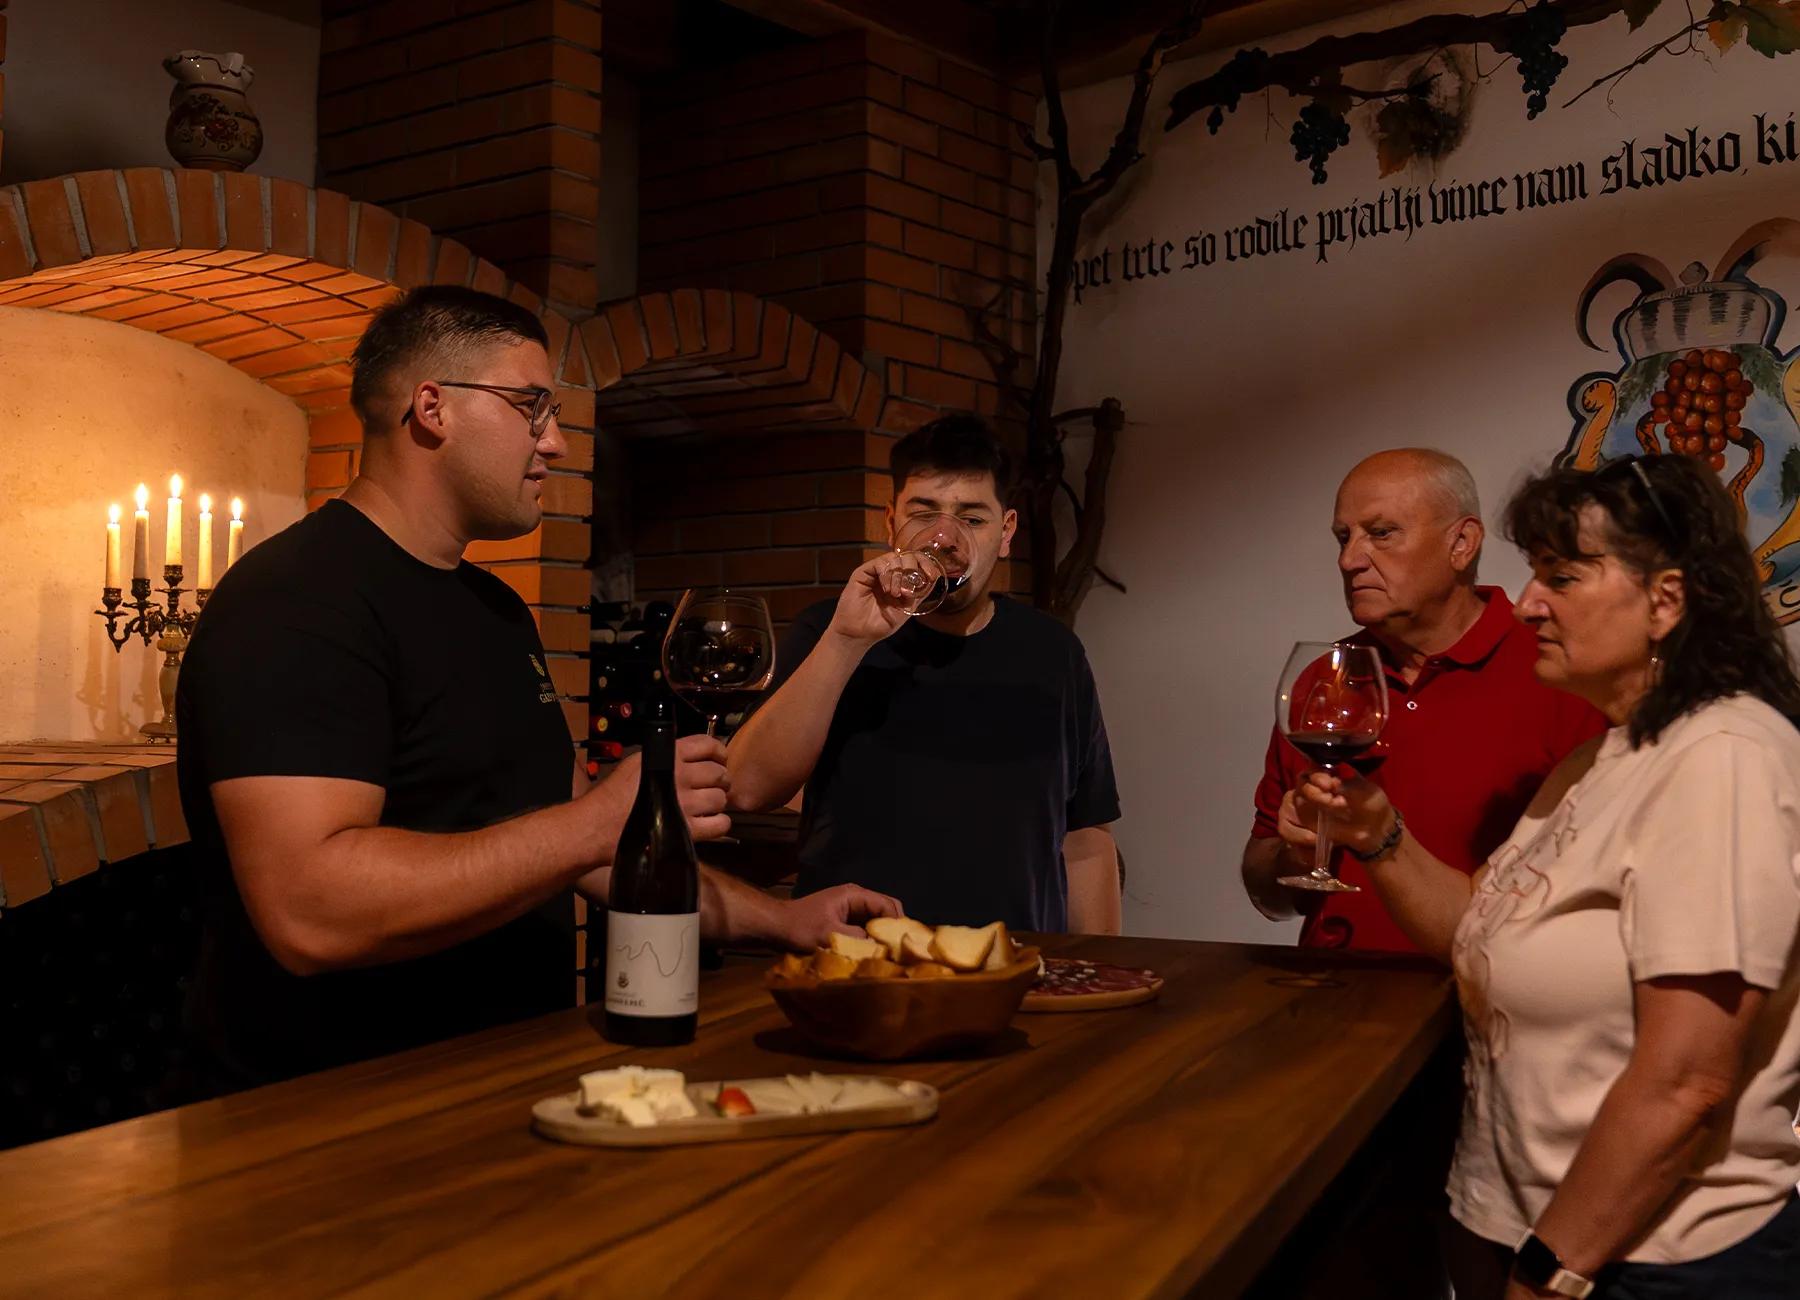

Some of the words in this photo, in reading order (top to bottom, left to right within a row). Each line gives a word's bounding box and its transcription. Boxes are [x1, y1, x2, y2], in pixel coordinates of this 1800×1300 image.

[1072, 247, 1112, 305] pet
[1123, 237, 1175, 281] trte
[1182, 230, 1216, 269] so
[1224, 208, 1309, 262] rodile
[1428, 178, 1508, 225] vince
[1512, 160, 1589, 212] nam
[1752, 111, 1800, 166] ki
